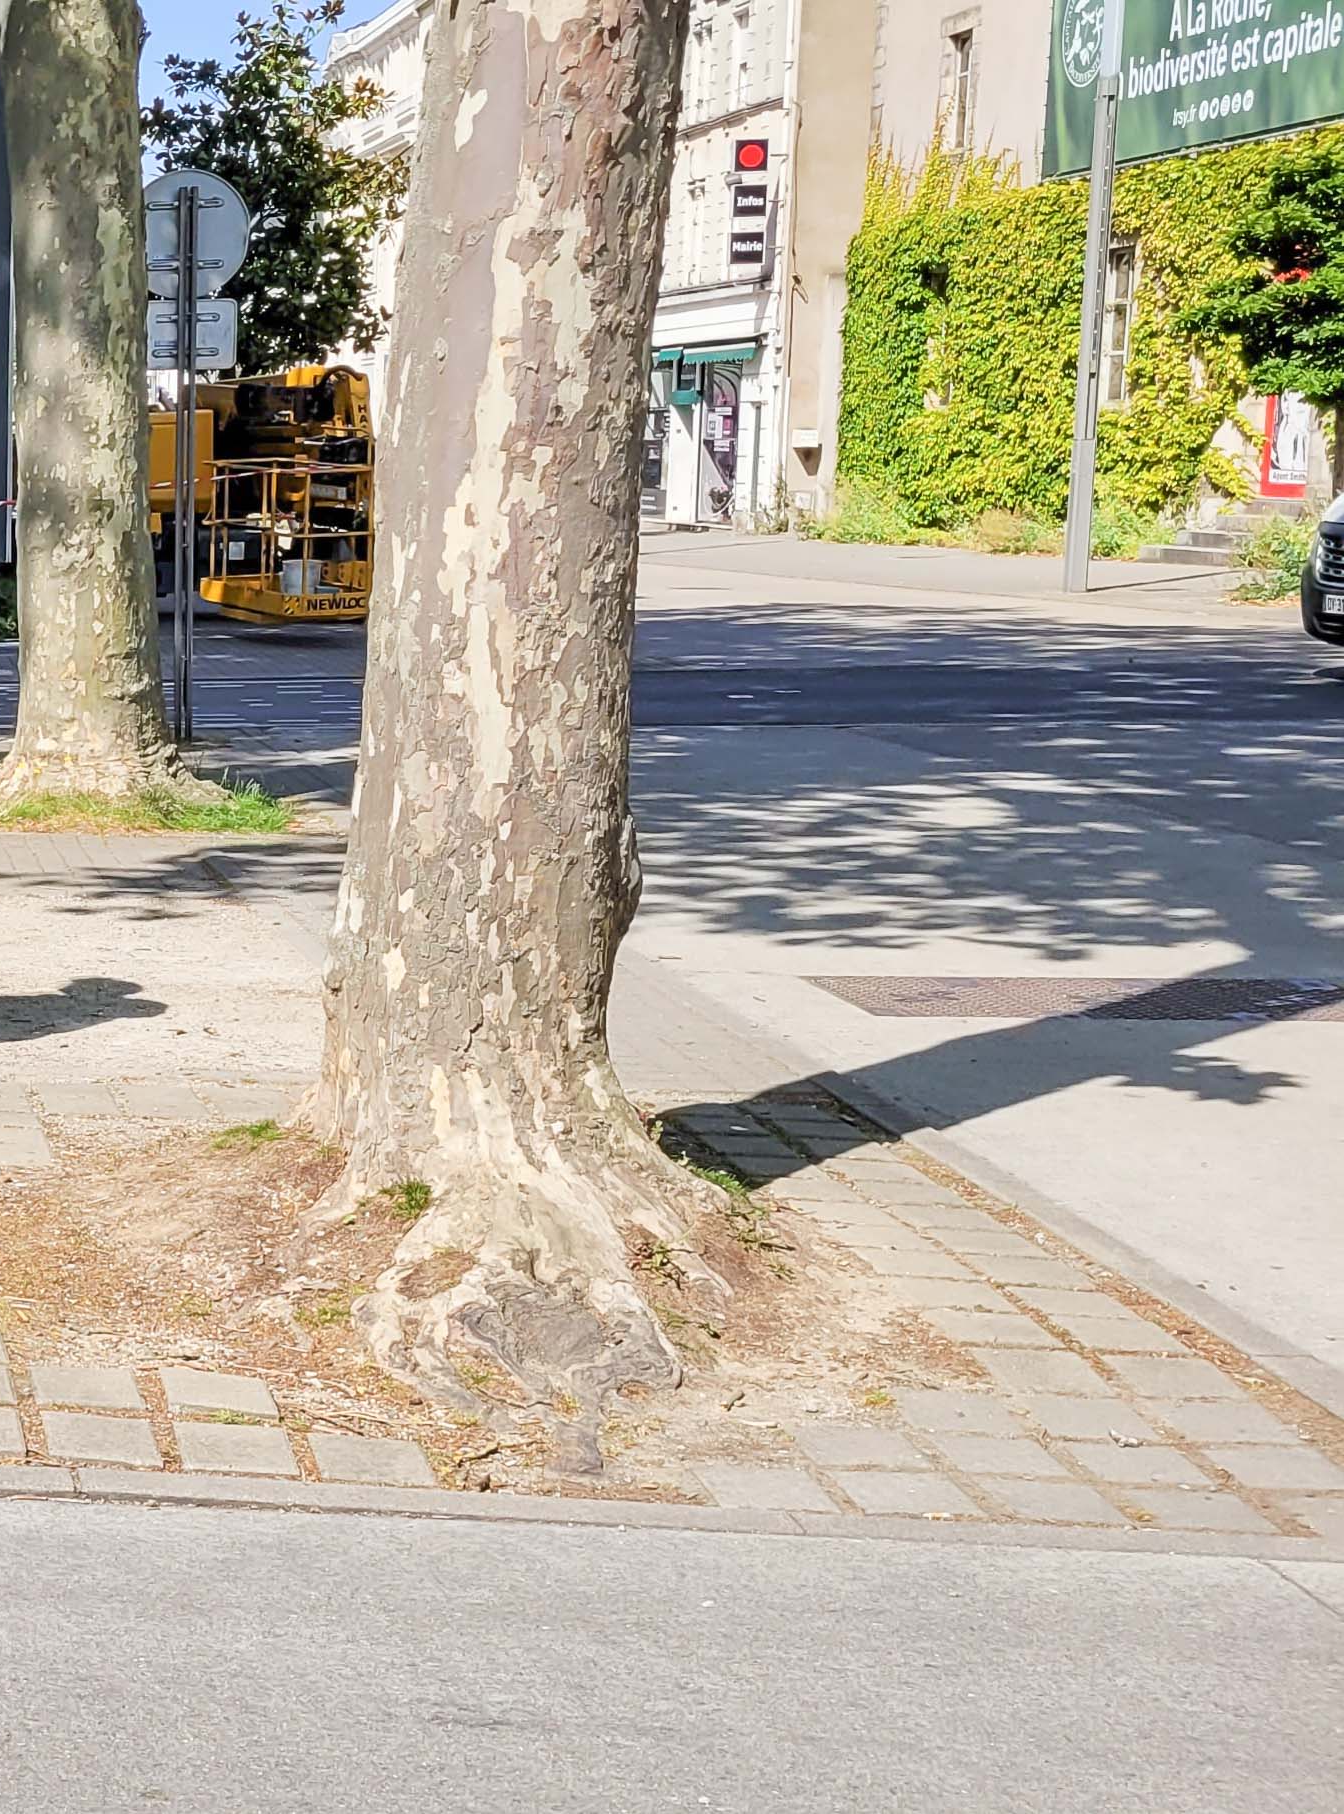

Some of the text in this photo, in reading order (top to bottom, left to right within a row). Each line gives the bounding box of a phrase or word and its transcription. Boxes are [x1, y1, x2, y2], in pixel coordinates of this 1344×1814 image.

[1187, 0, 1205, 36] La
[1128, 32, 1228, 98] biodiversité
[1231, 27, 1260, 72] est
[1263, 0, 1344, 73] capitale
[736, 196, 764, 207] Infos
[732, 240, 763, 252] Mairie
[307, 597, 366, 611] NEWLOC
